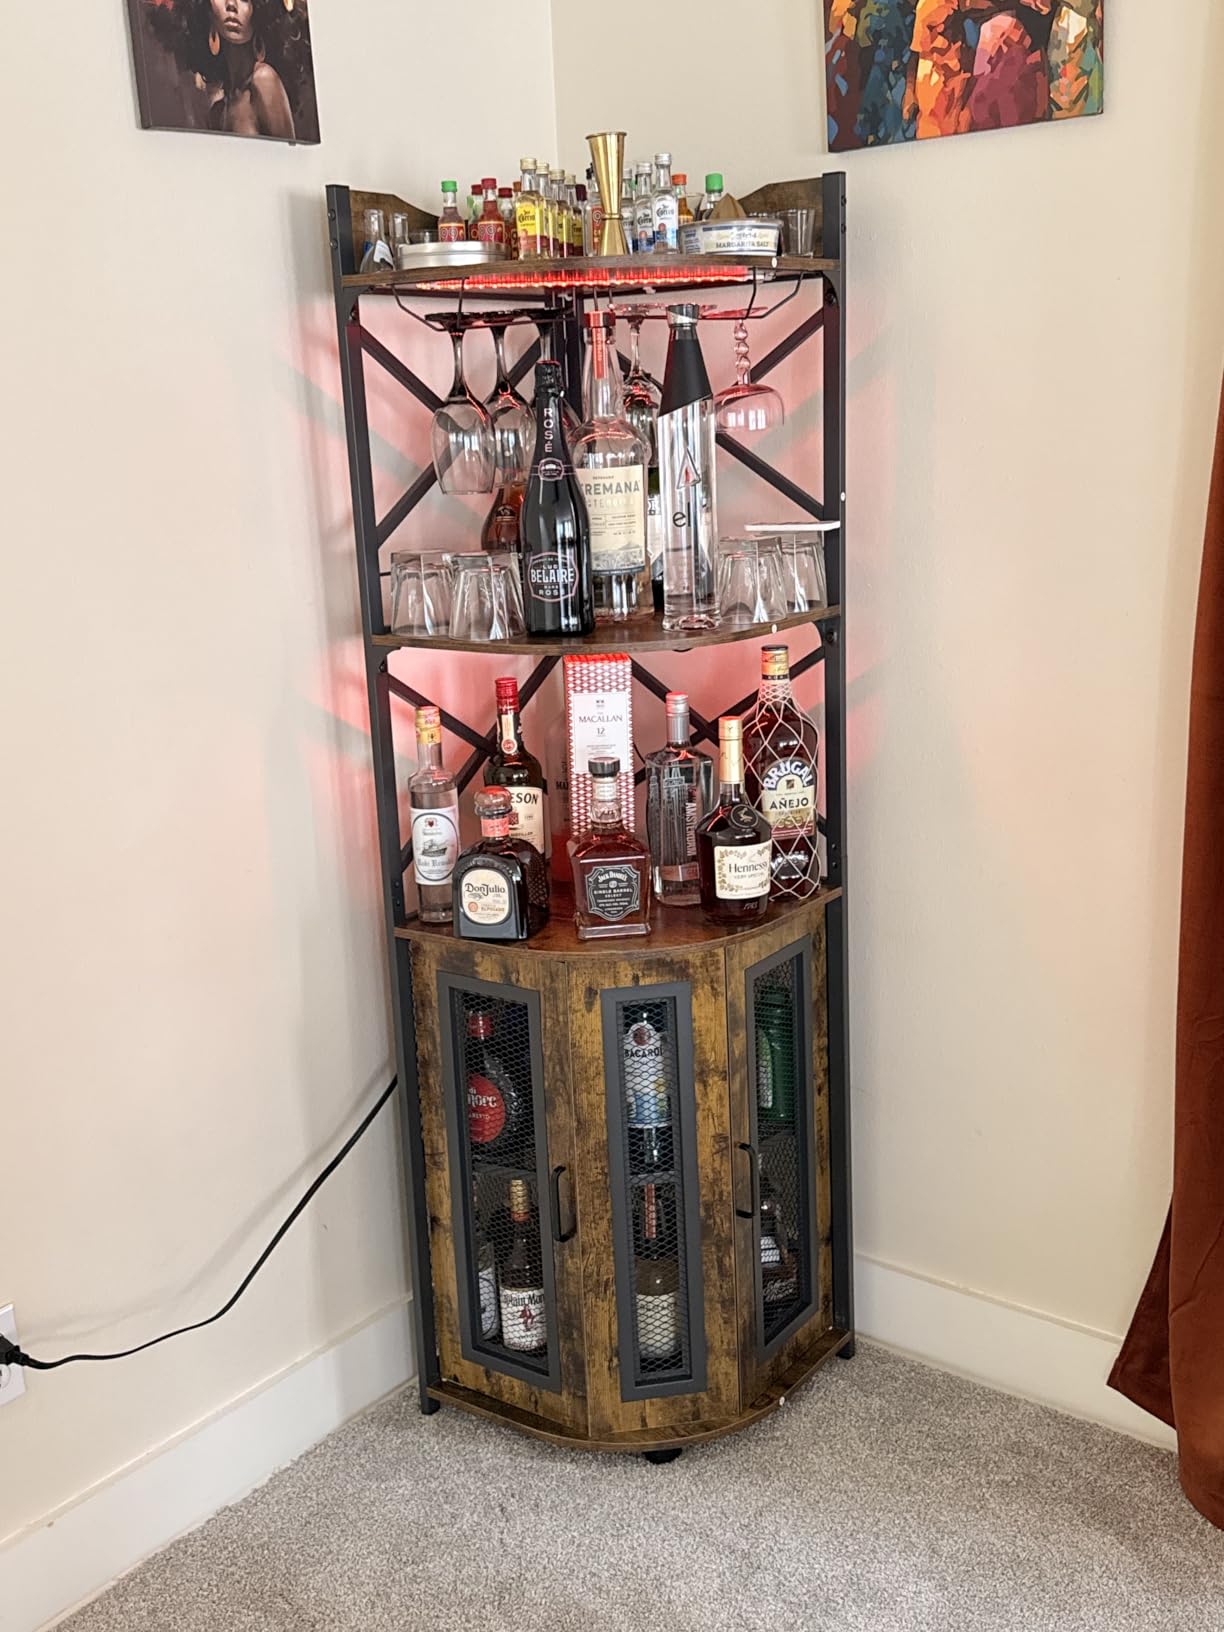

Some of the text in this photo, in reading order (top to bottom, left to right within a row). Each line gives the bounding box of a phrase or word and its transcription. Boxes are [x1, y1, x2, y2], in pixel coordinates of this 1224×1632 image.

[715, 241, 755, 249] MARGARITA
[544, 407, 554, 453] ROSÉ
[531, 568, 575, 583] BELAIRE
[578, 714, 623, 723] MACALLAN
[596, 727, 606, 735] 12
[763, 761, 813, 790] BRUGAL
[769, 797, 809, 810] AÑEJO
[685, 802, 698, 857] AMSTERDAM
